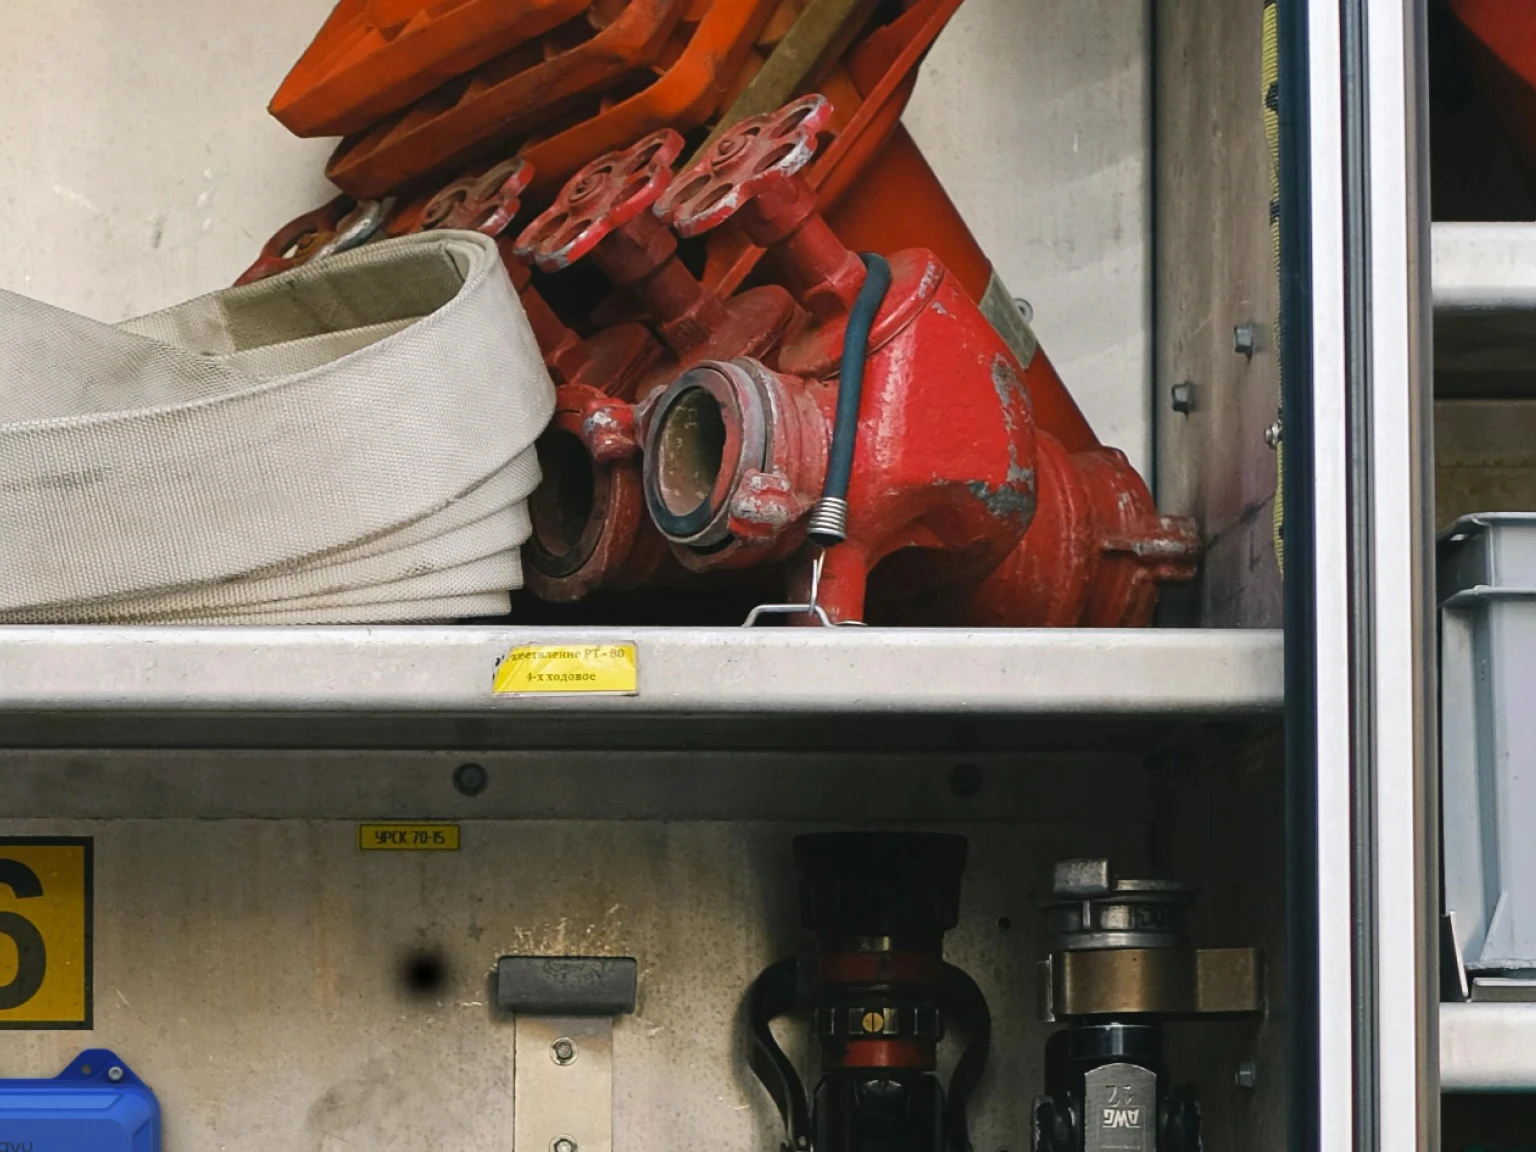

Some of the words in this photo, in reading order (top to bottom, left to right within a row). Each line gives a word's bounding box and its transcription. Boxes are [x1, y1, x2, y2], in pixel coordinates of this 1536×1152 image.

[375, 830, 406, 844] УРСК
[413, 831, 445, 844] 70-15
[1102, 1107, 1141, 1129] AWG
